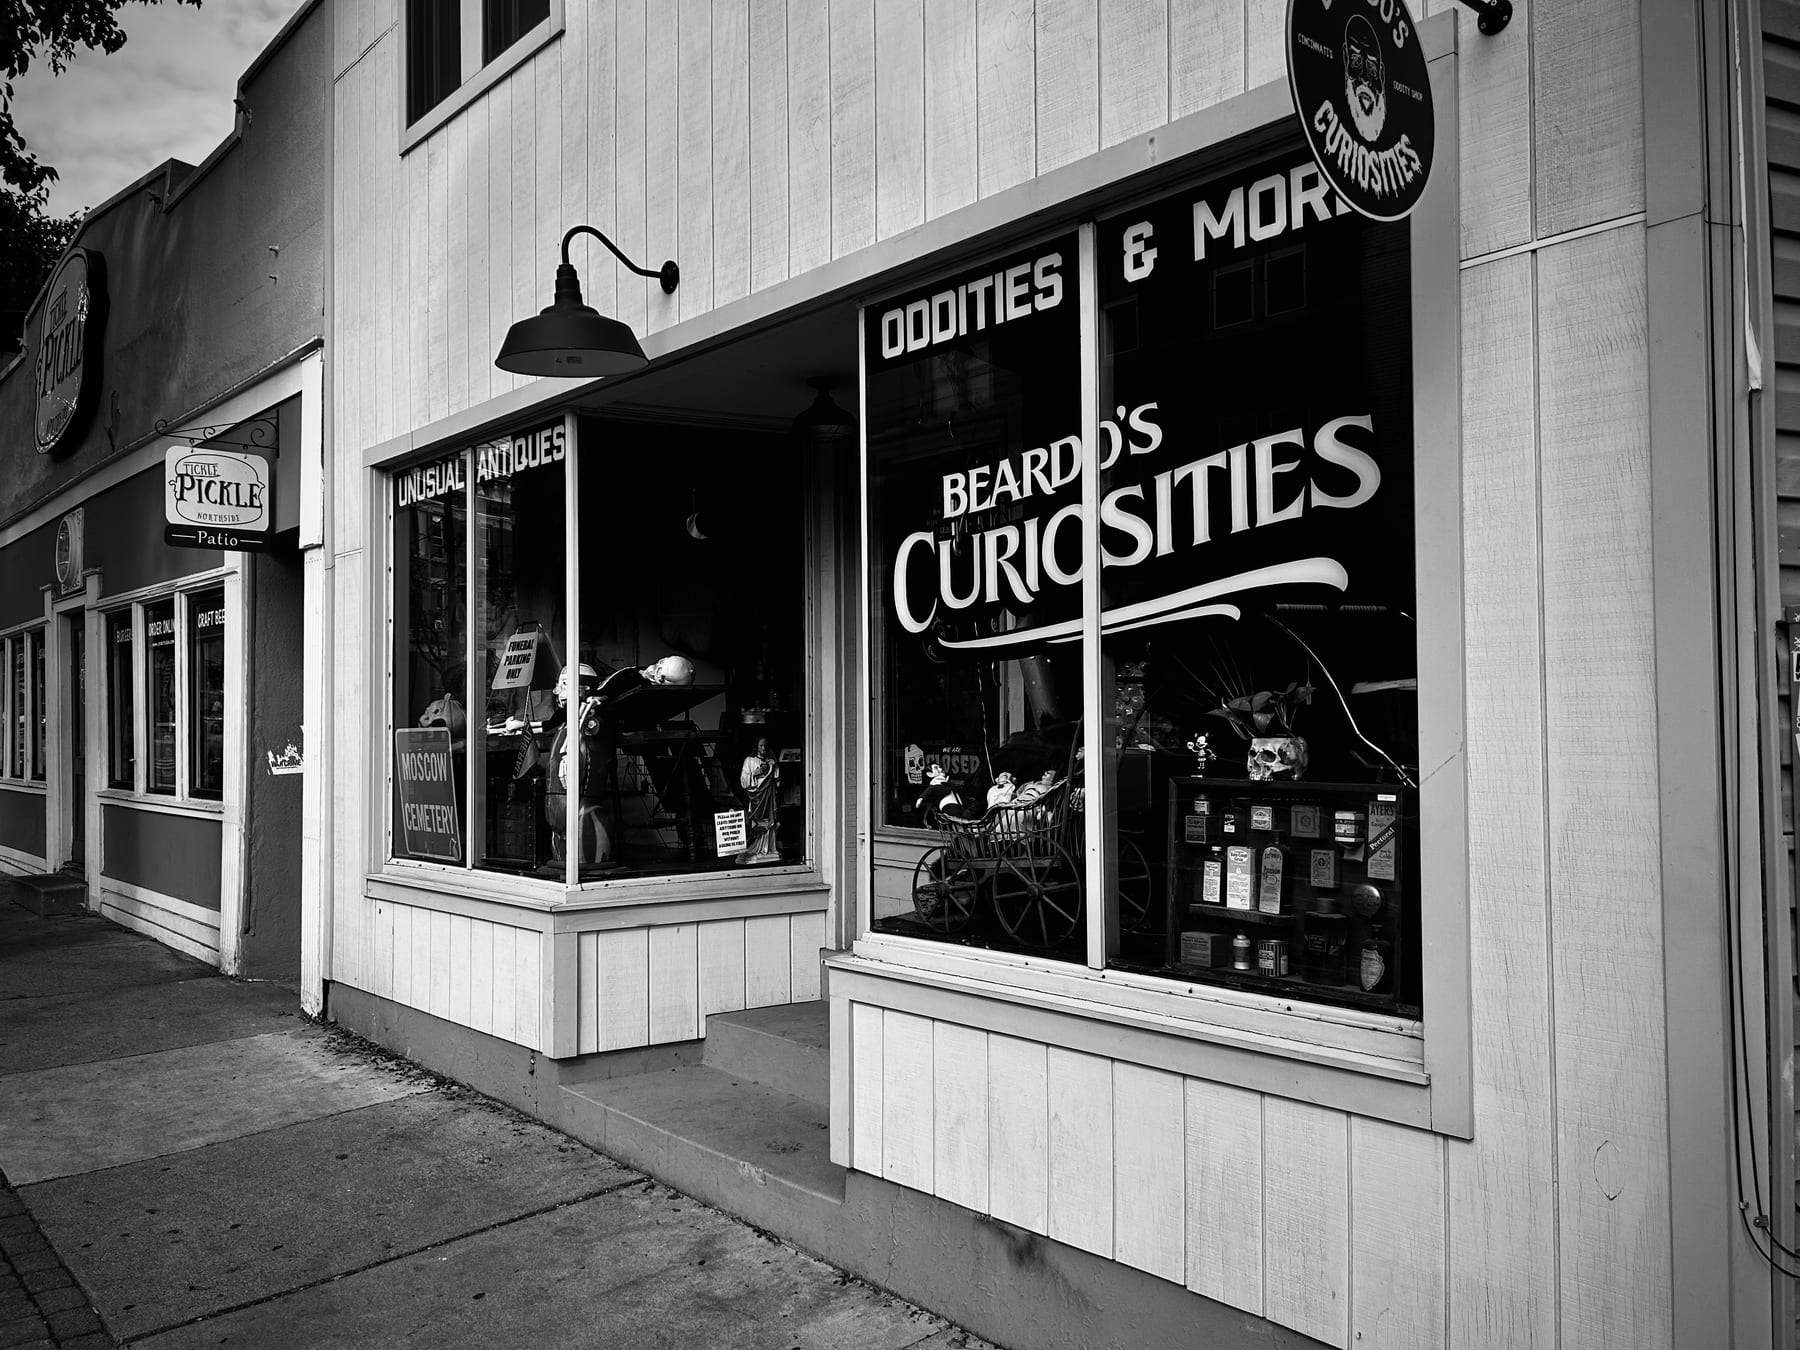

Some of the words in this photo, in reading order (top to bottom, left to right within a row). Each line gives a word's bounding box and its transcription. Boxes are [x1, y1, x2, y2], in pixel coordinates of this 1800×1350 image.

[1313, 99, 1422, 200] CURIOSITIES
[881, 252, 1063, 359] ODDITIES
[1123, 220, 1158, 282] &
[1193, 161, 1353, 262] MOR
[183, 464, 219, 476] TICKLE
[398, 458, 465, 507] UNUSUAL
[476, 424, 566, 484] ANTIQUES
[177, 473, 263, 509] PICKLE
[197, 511, 241, 523] NORTHSIDE
[893, 414, 1381, 634] CURIOSITIES
[196, 530, 239, 547] Patio
[198, 610, 214, 628] CRAFT
[215, 608, 225, 625] BEE
[508, 638, 535, 653] FUNERAL
[503, 652, 532, 667] PARKING
[505, 667, 523, 680] ONLY
[401, 752, 448, 782] MOSCOW
[404, 803, 455, 835] CEMETERY
[1369, 827, 1395, 850] Pectoral
